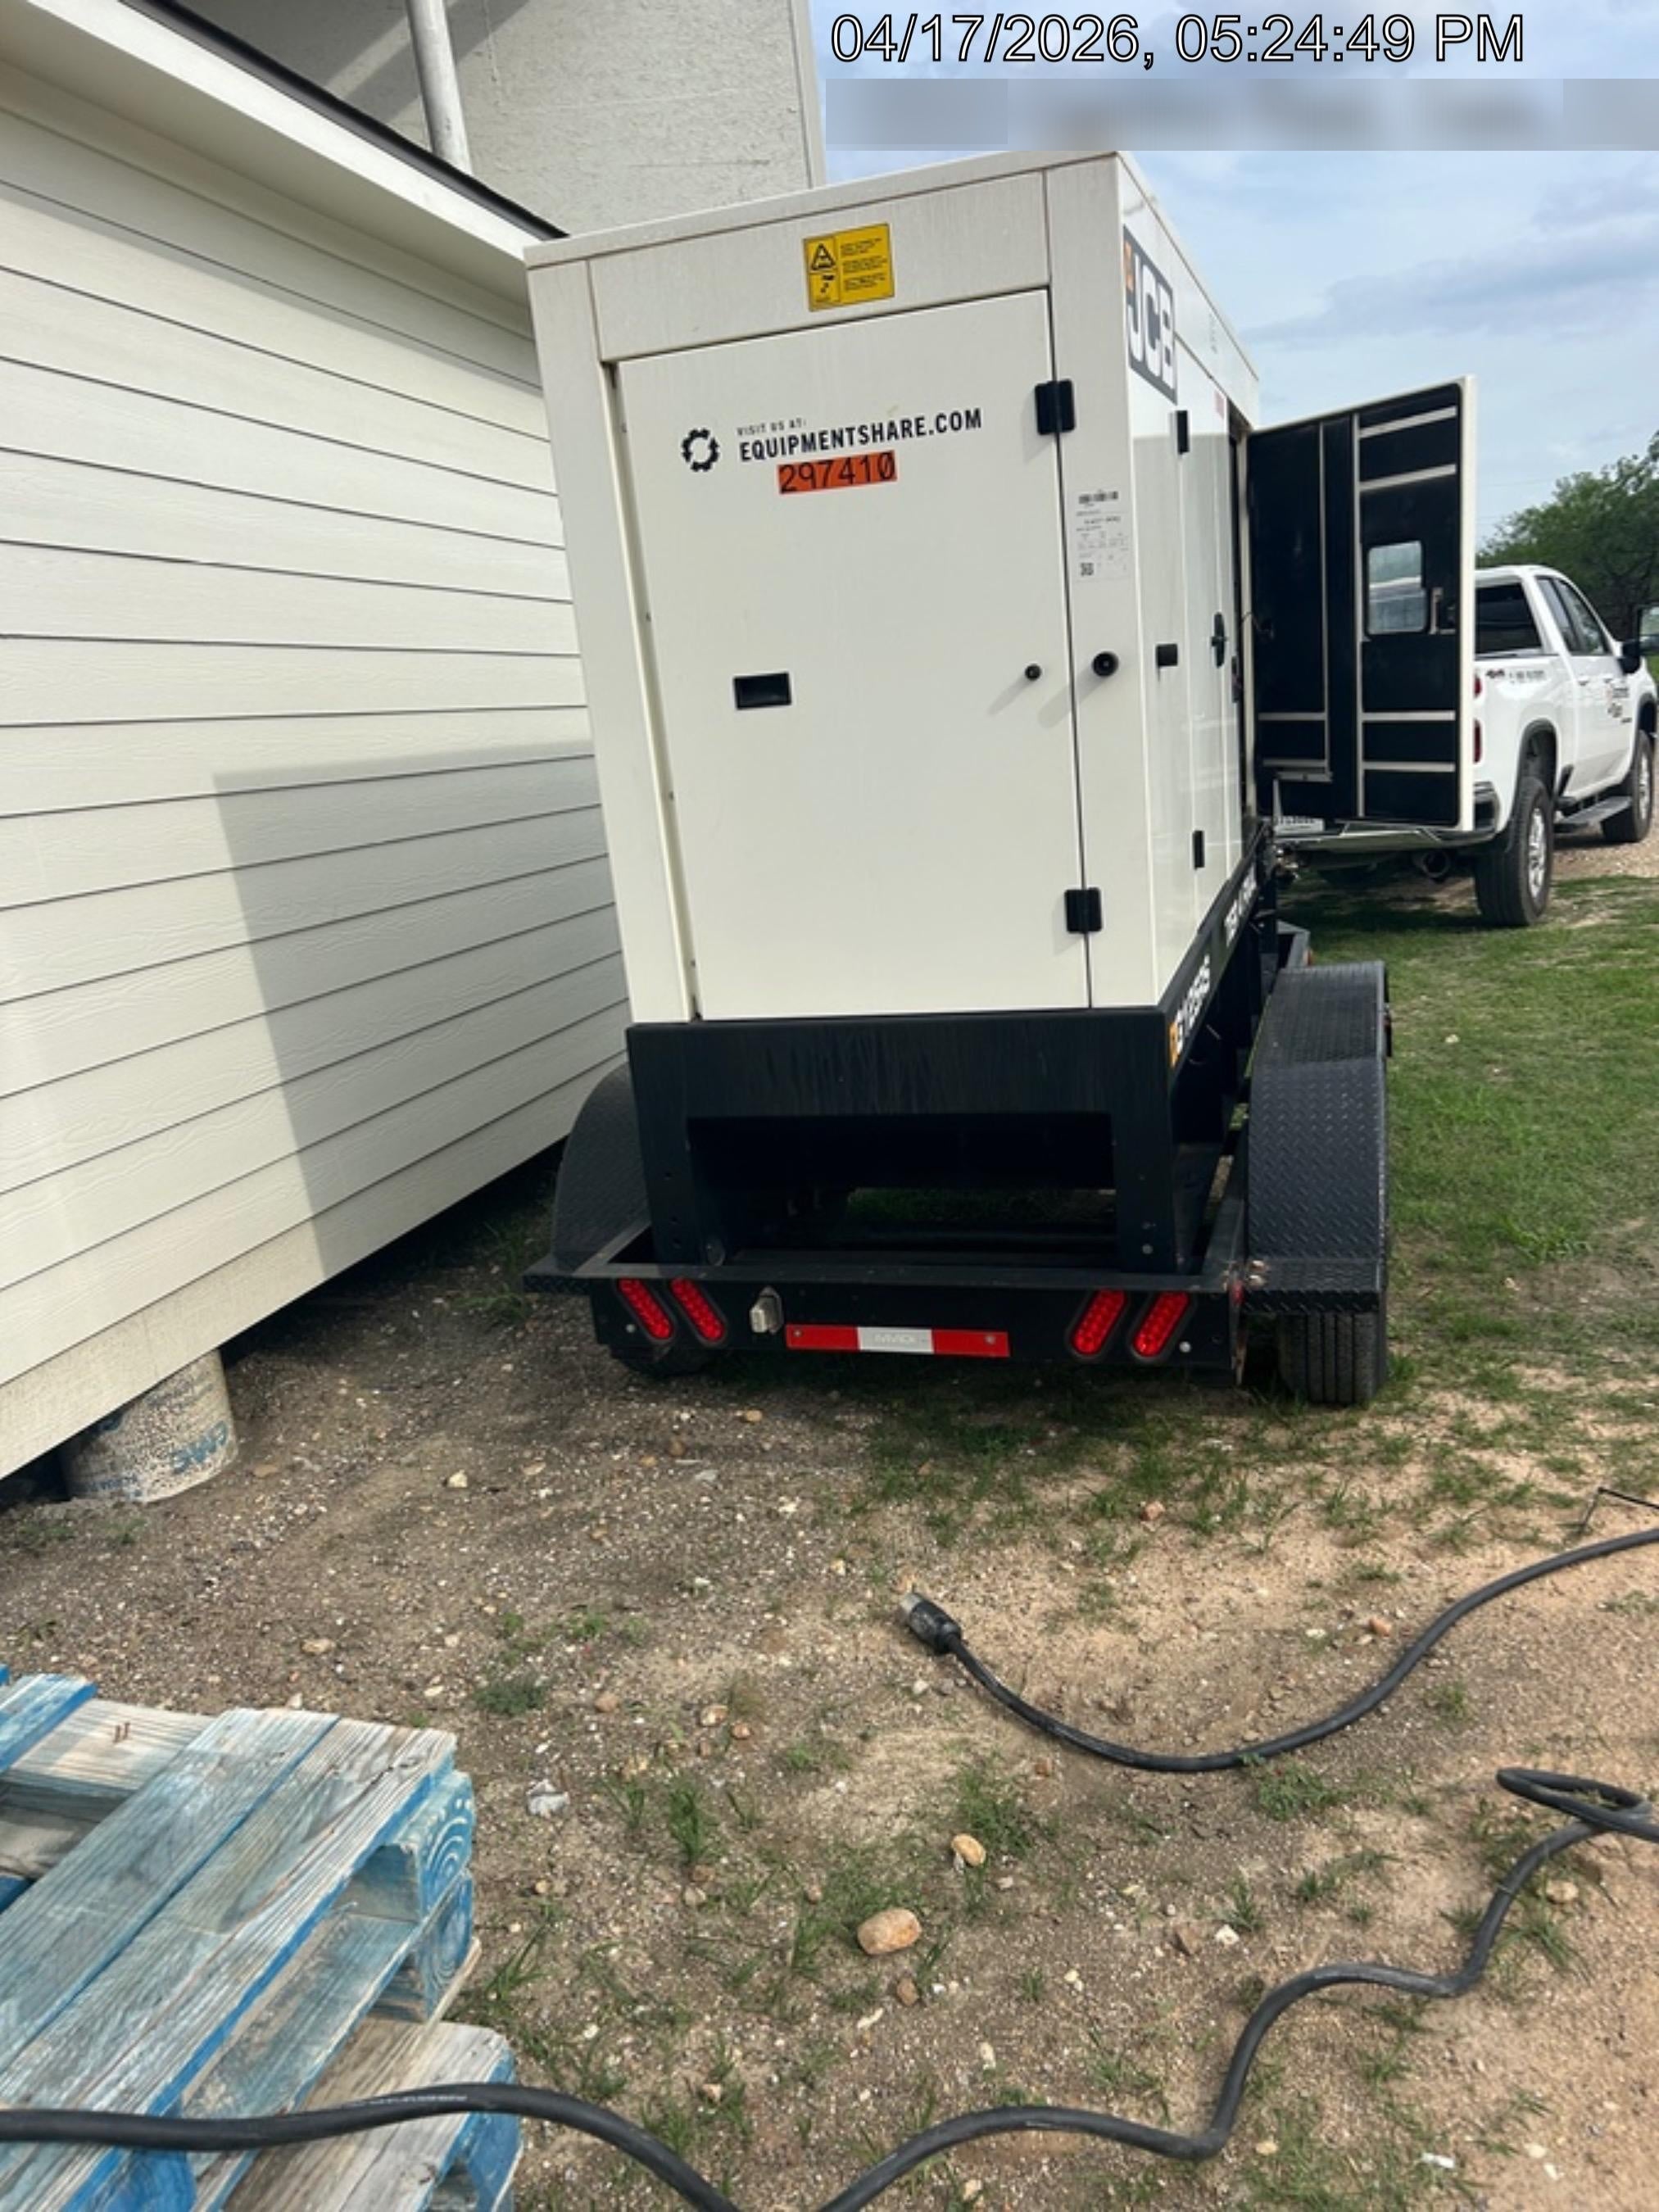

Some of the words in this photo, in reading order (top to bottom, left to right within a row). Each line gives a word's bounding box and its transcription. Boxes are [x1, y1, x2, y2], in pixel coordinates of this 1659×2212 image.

[1127, 252, 1175, 390] JCB
[740, 408, 982, 462] EQUIPMENTSHARE.COM
[779, 450, 896, 494] 297410
